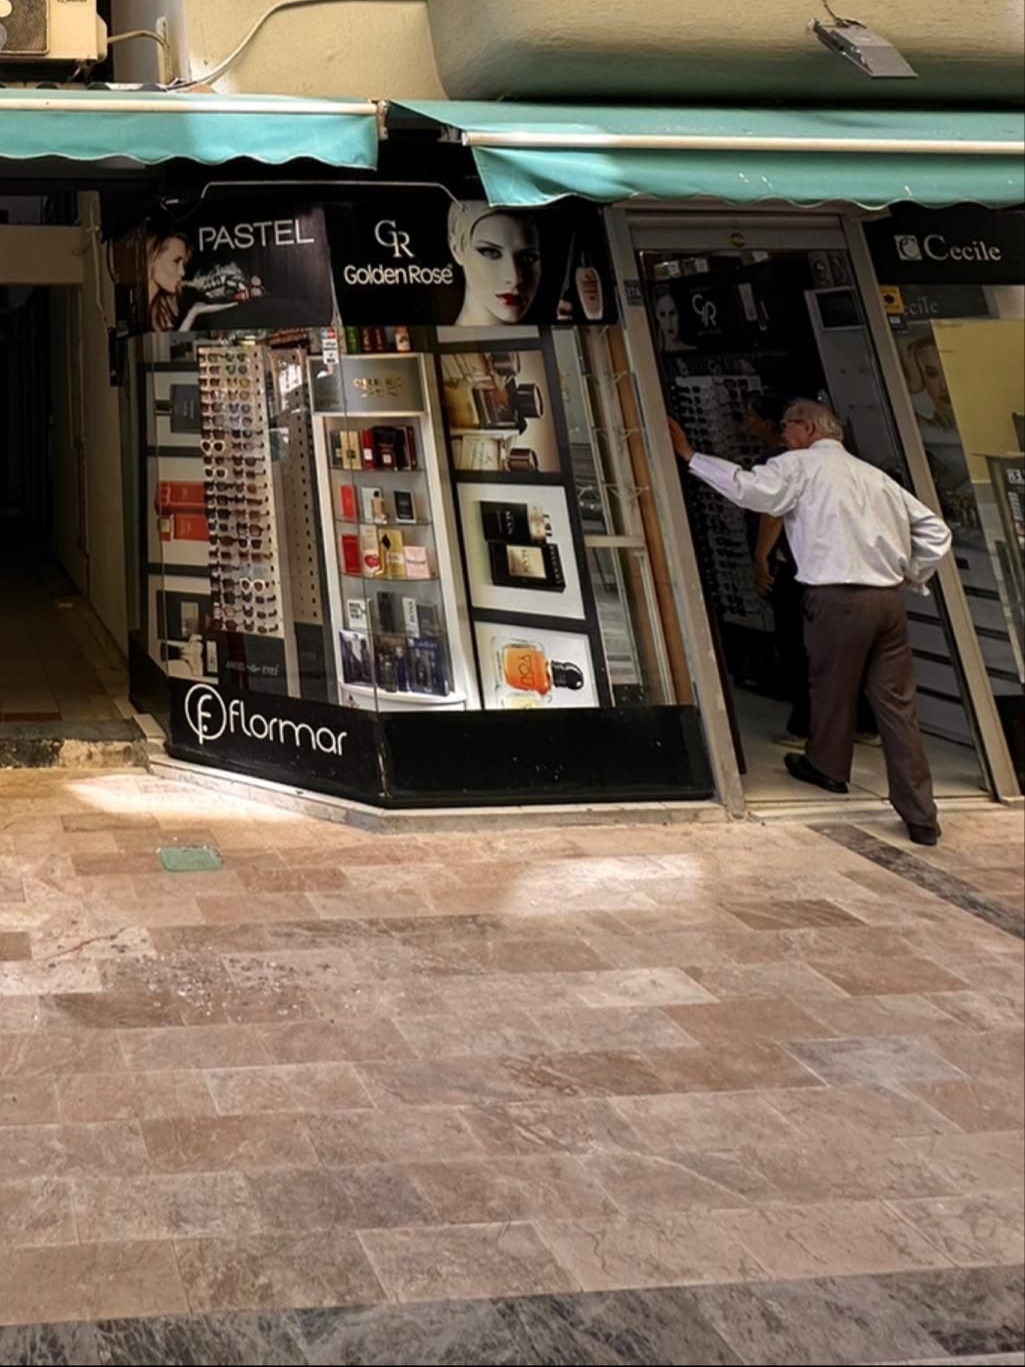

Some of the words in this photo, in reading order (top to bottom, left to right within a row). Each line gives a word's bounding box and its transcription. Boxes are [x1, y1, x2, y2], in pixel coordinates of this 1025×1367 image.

[198, 218, 315, 252] PASTEL
[923, 234, 1002, 261] Cecile
[343, 263, 408, 285] Golden
[408, 264, 454, 285] Rose
[228, 699, 348, 756] flormar
